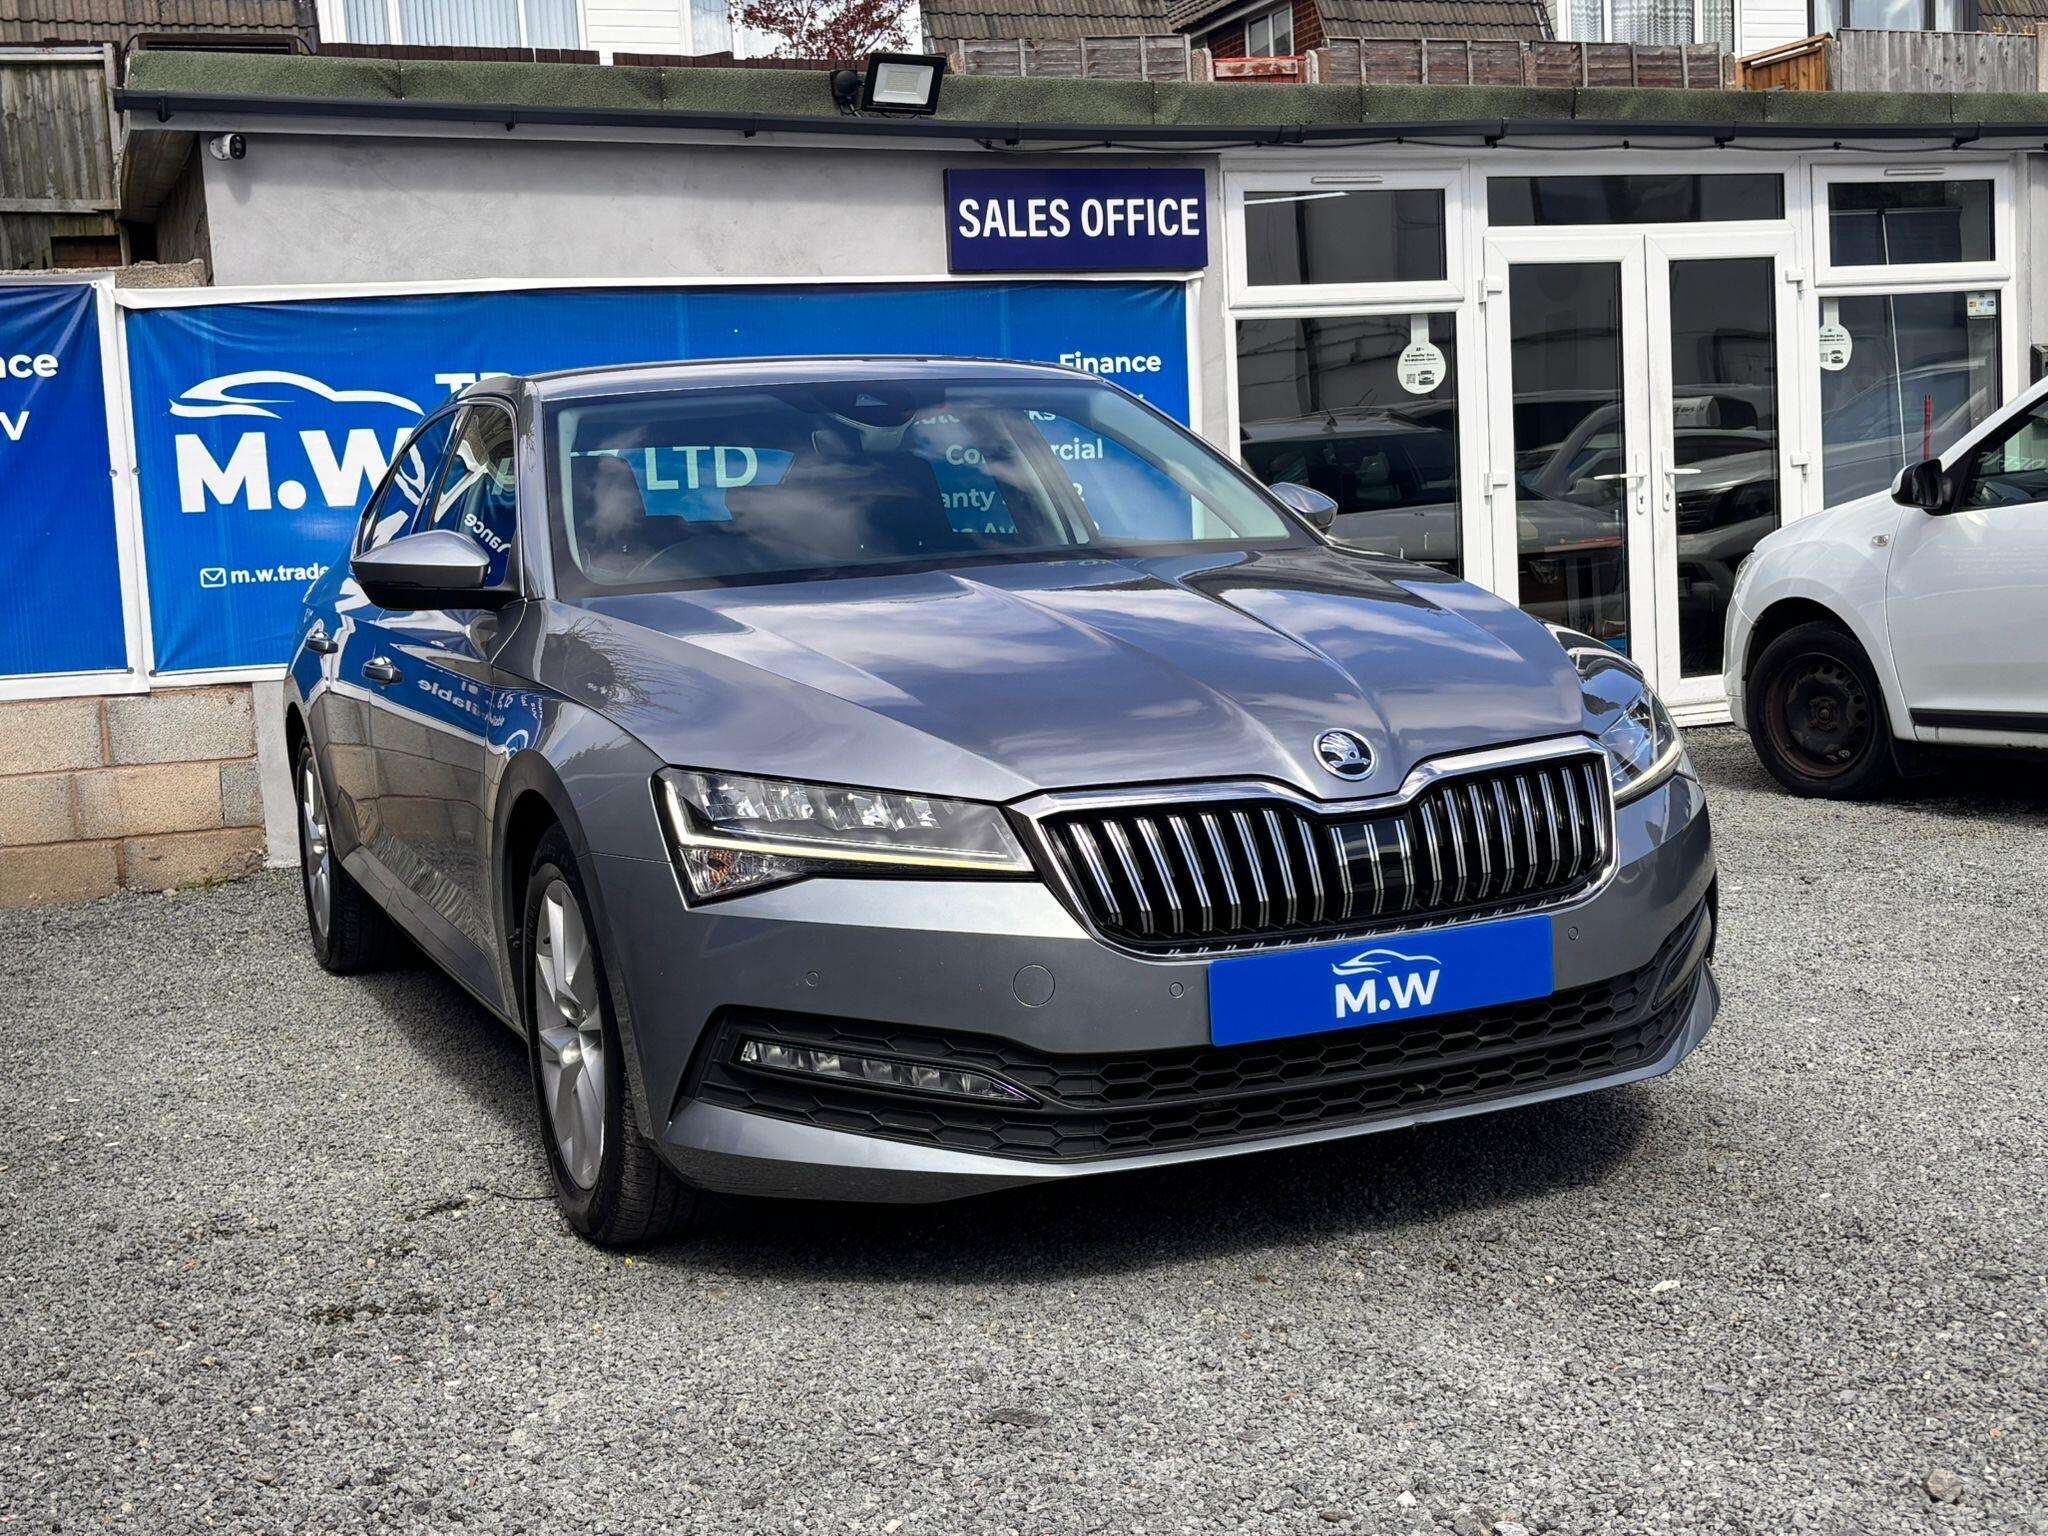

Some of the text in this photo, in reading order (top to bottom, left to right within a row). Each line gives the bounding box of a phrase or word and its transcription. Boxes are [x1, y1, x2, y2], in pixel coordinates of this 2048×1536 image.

[958, 197, 1201, 239] SALES OFFICE
[1059, 351, 1163, 374] Finance
[174, 427, 415, 514] M.W
[644, 445, 759, 491] LTD
[1335, 969, 1441, 1019] M.W
